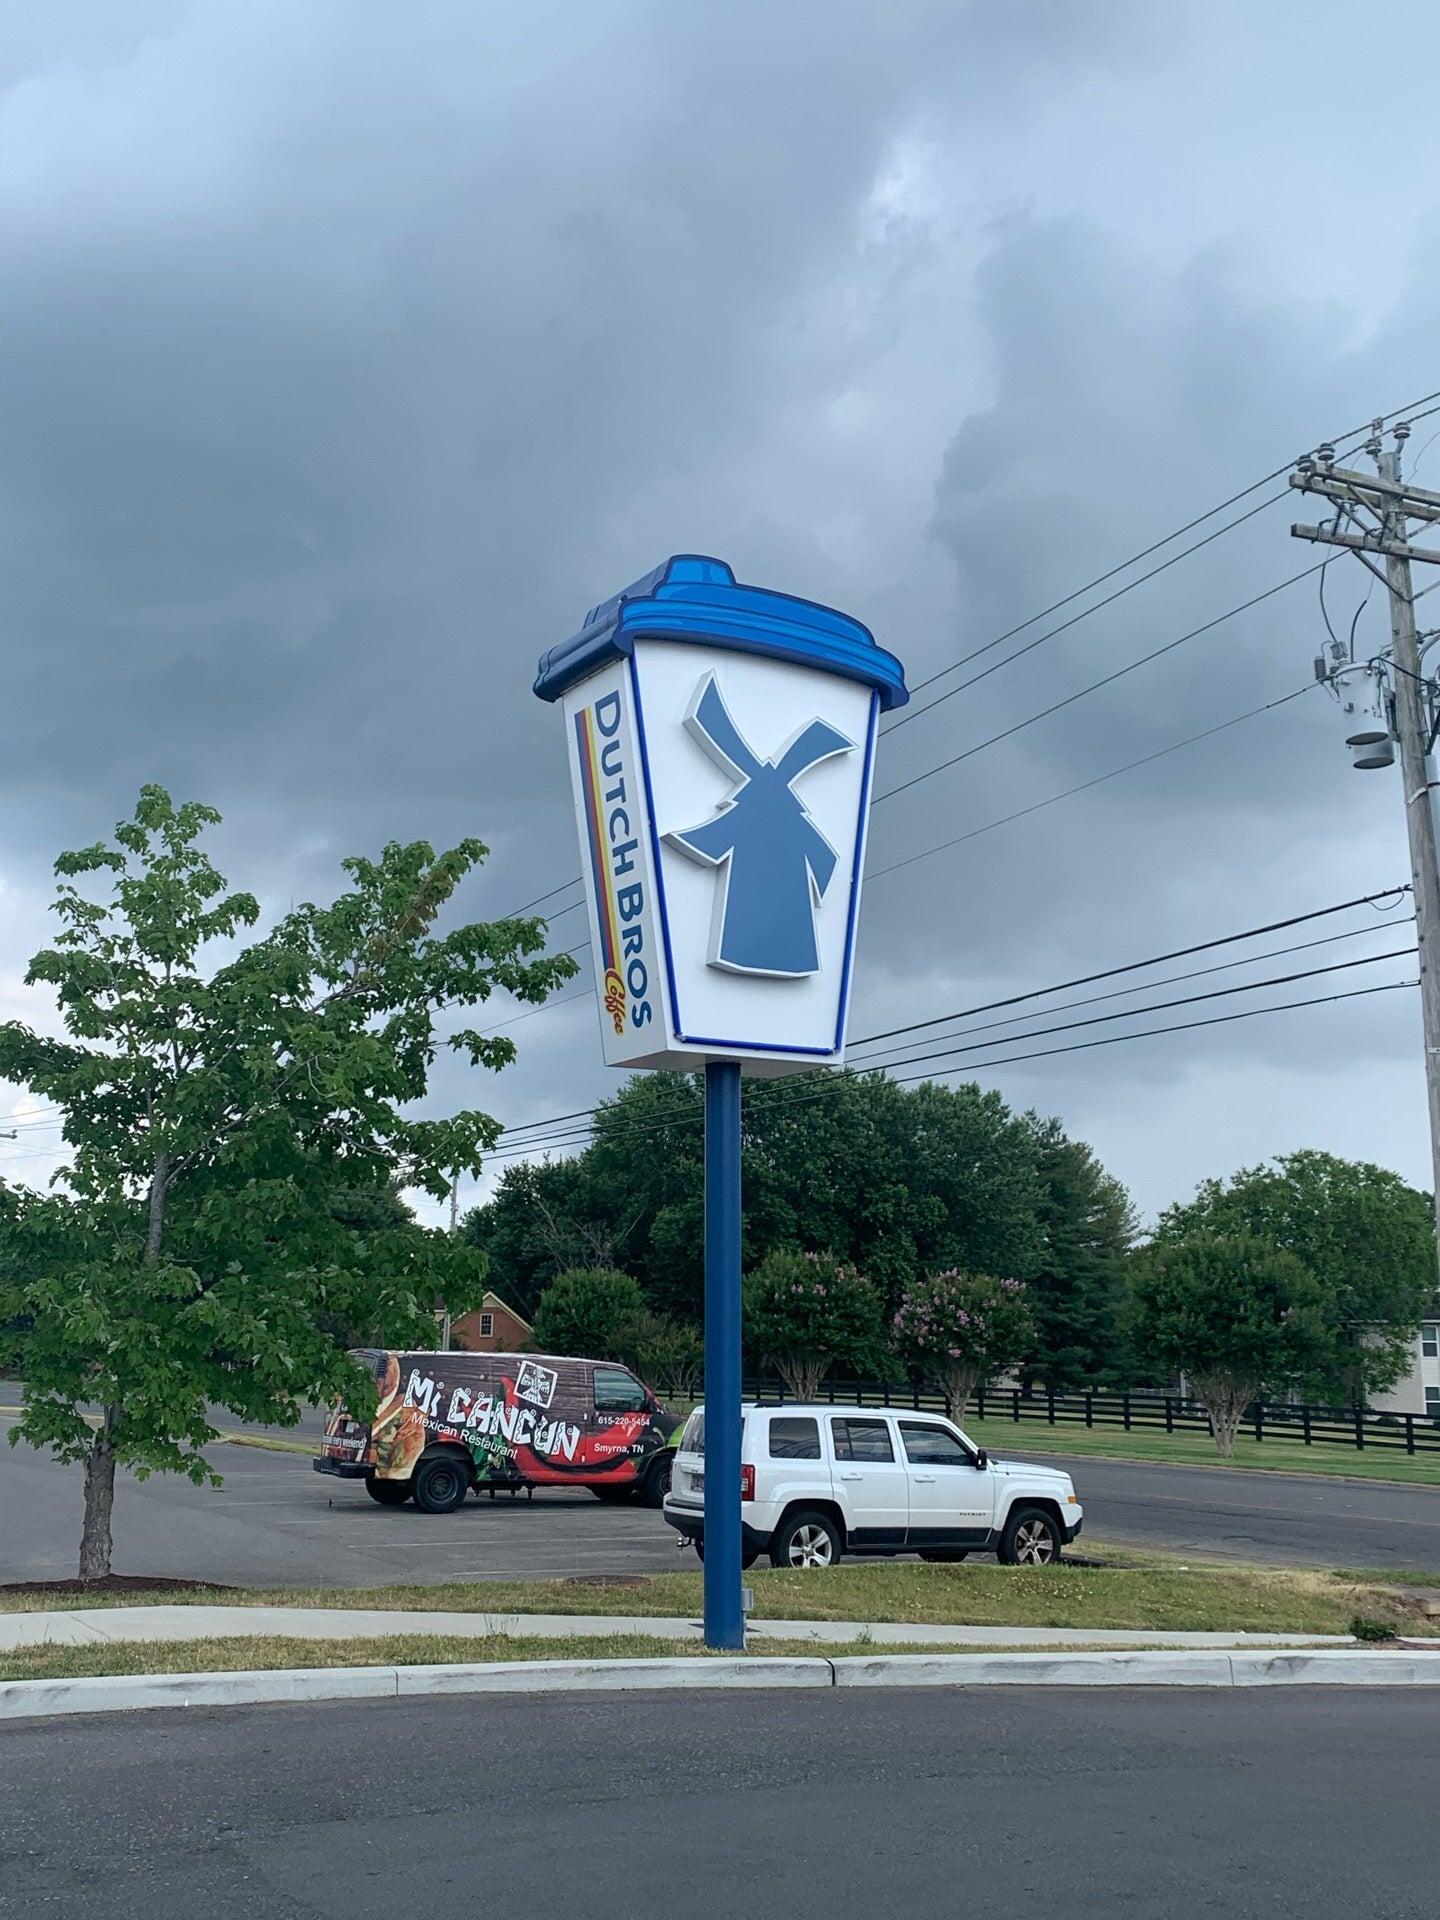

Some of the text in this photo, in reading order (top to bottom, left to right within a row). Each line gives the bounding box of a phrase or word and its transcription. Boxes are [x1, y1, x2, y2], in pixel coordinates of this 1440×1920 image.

[595, 689, 652, 1028] DUTCH BROS
[604, 968, 626, 1035] Coffee
[411, 1412, 518, 1460] Mexican Restaurant
[598, 1416, 650, 1426] 615-220-5454
[594, 1443, 644, 1454] Smyrna, TN
